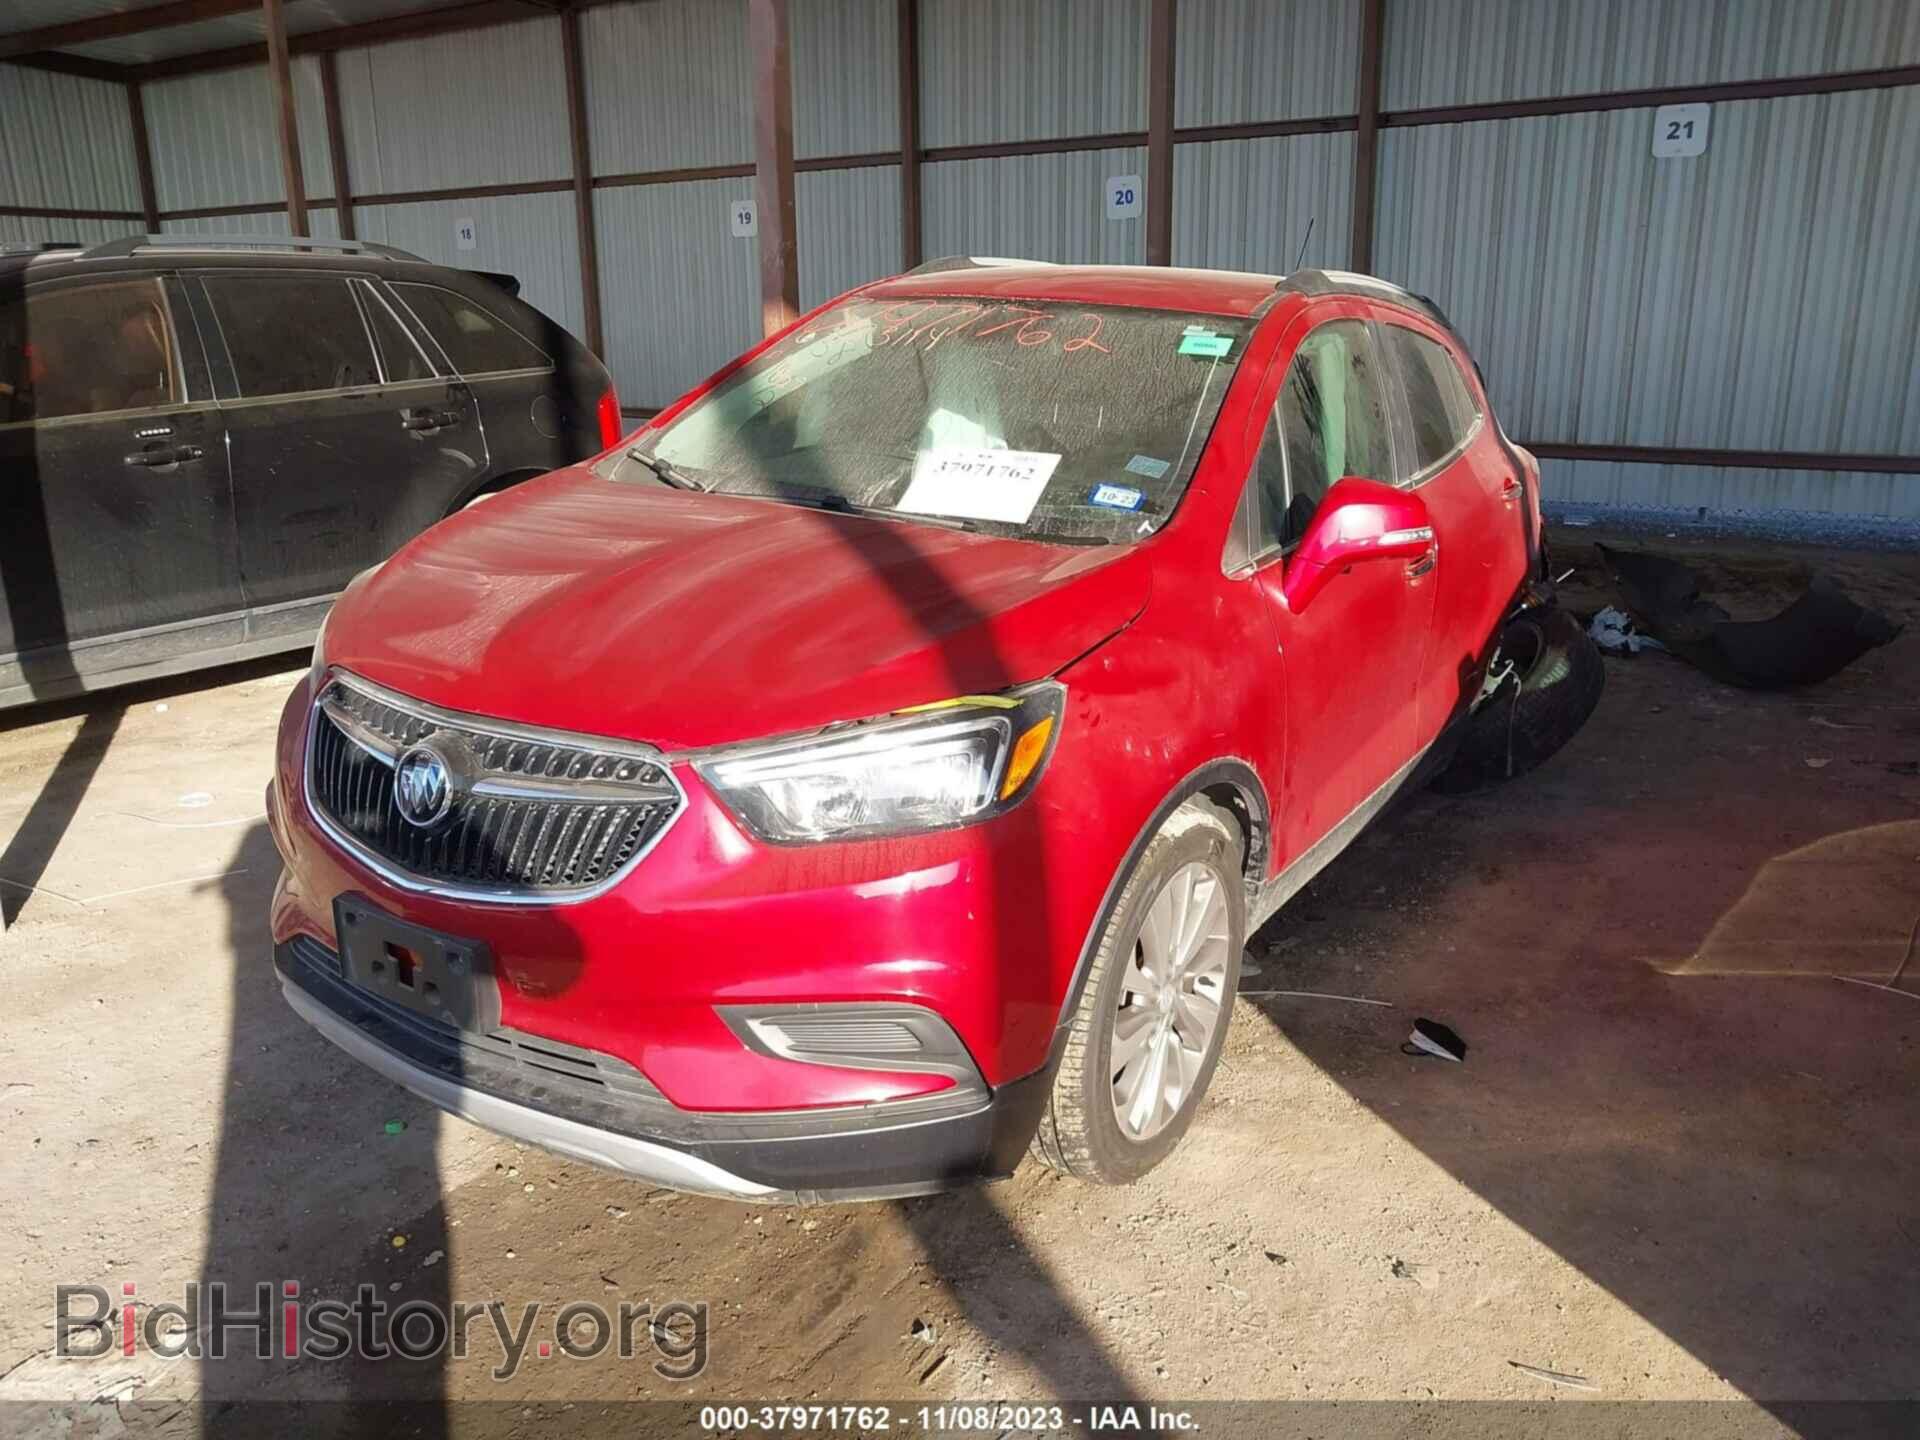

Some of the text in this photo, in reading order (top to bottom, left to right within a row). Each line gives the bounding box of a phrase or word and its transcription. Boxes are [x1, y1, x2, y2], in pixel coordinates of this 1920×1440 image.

[1667, 120, 1694, 140] 21
[1115, 189, 1134, 205] 20
[737, 211, 752, 225] 19
[461, 228, 472, 240] 18
